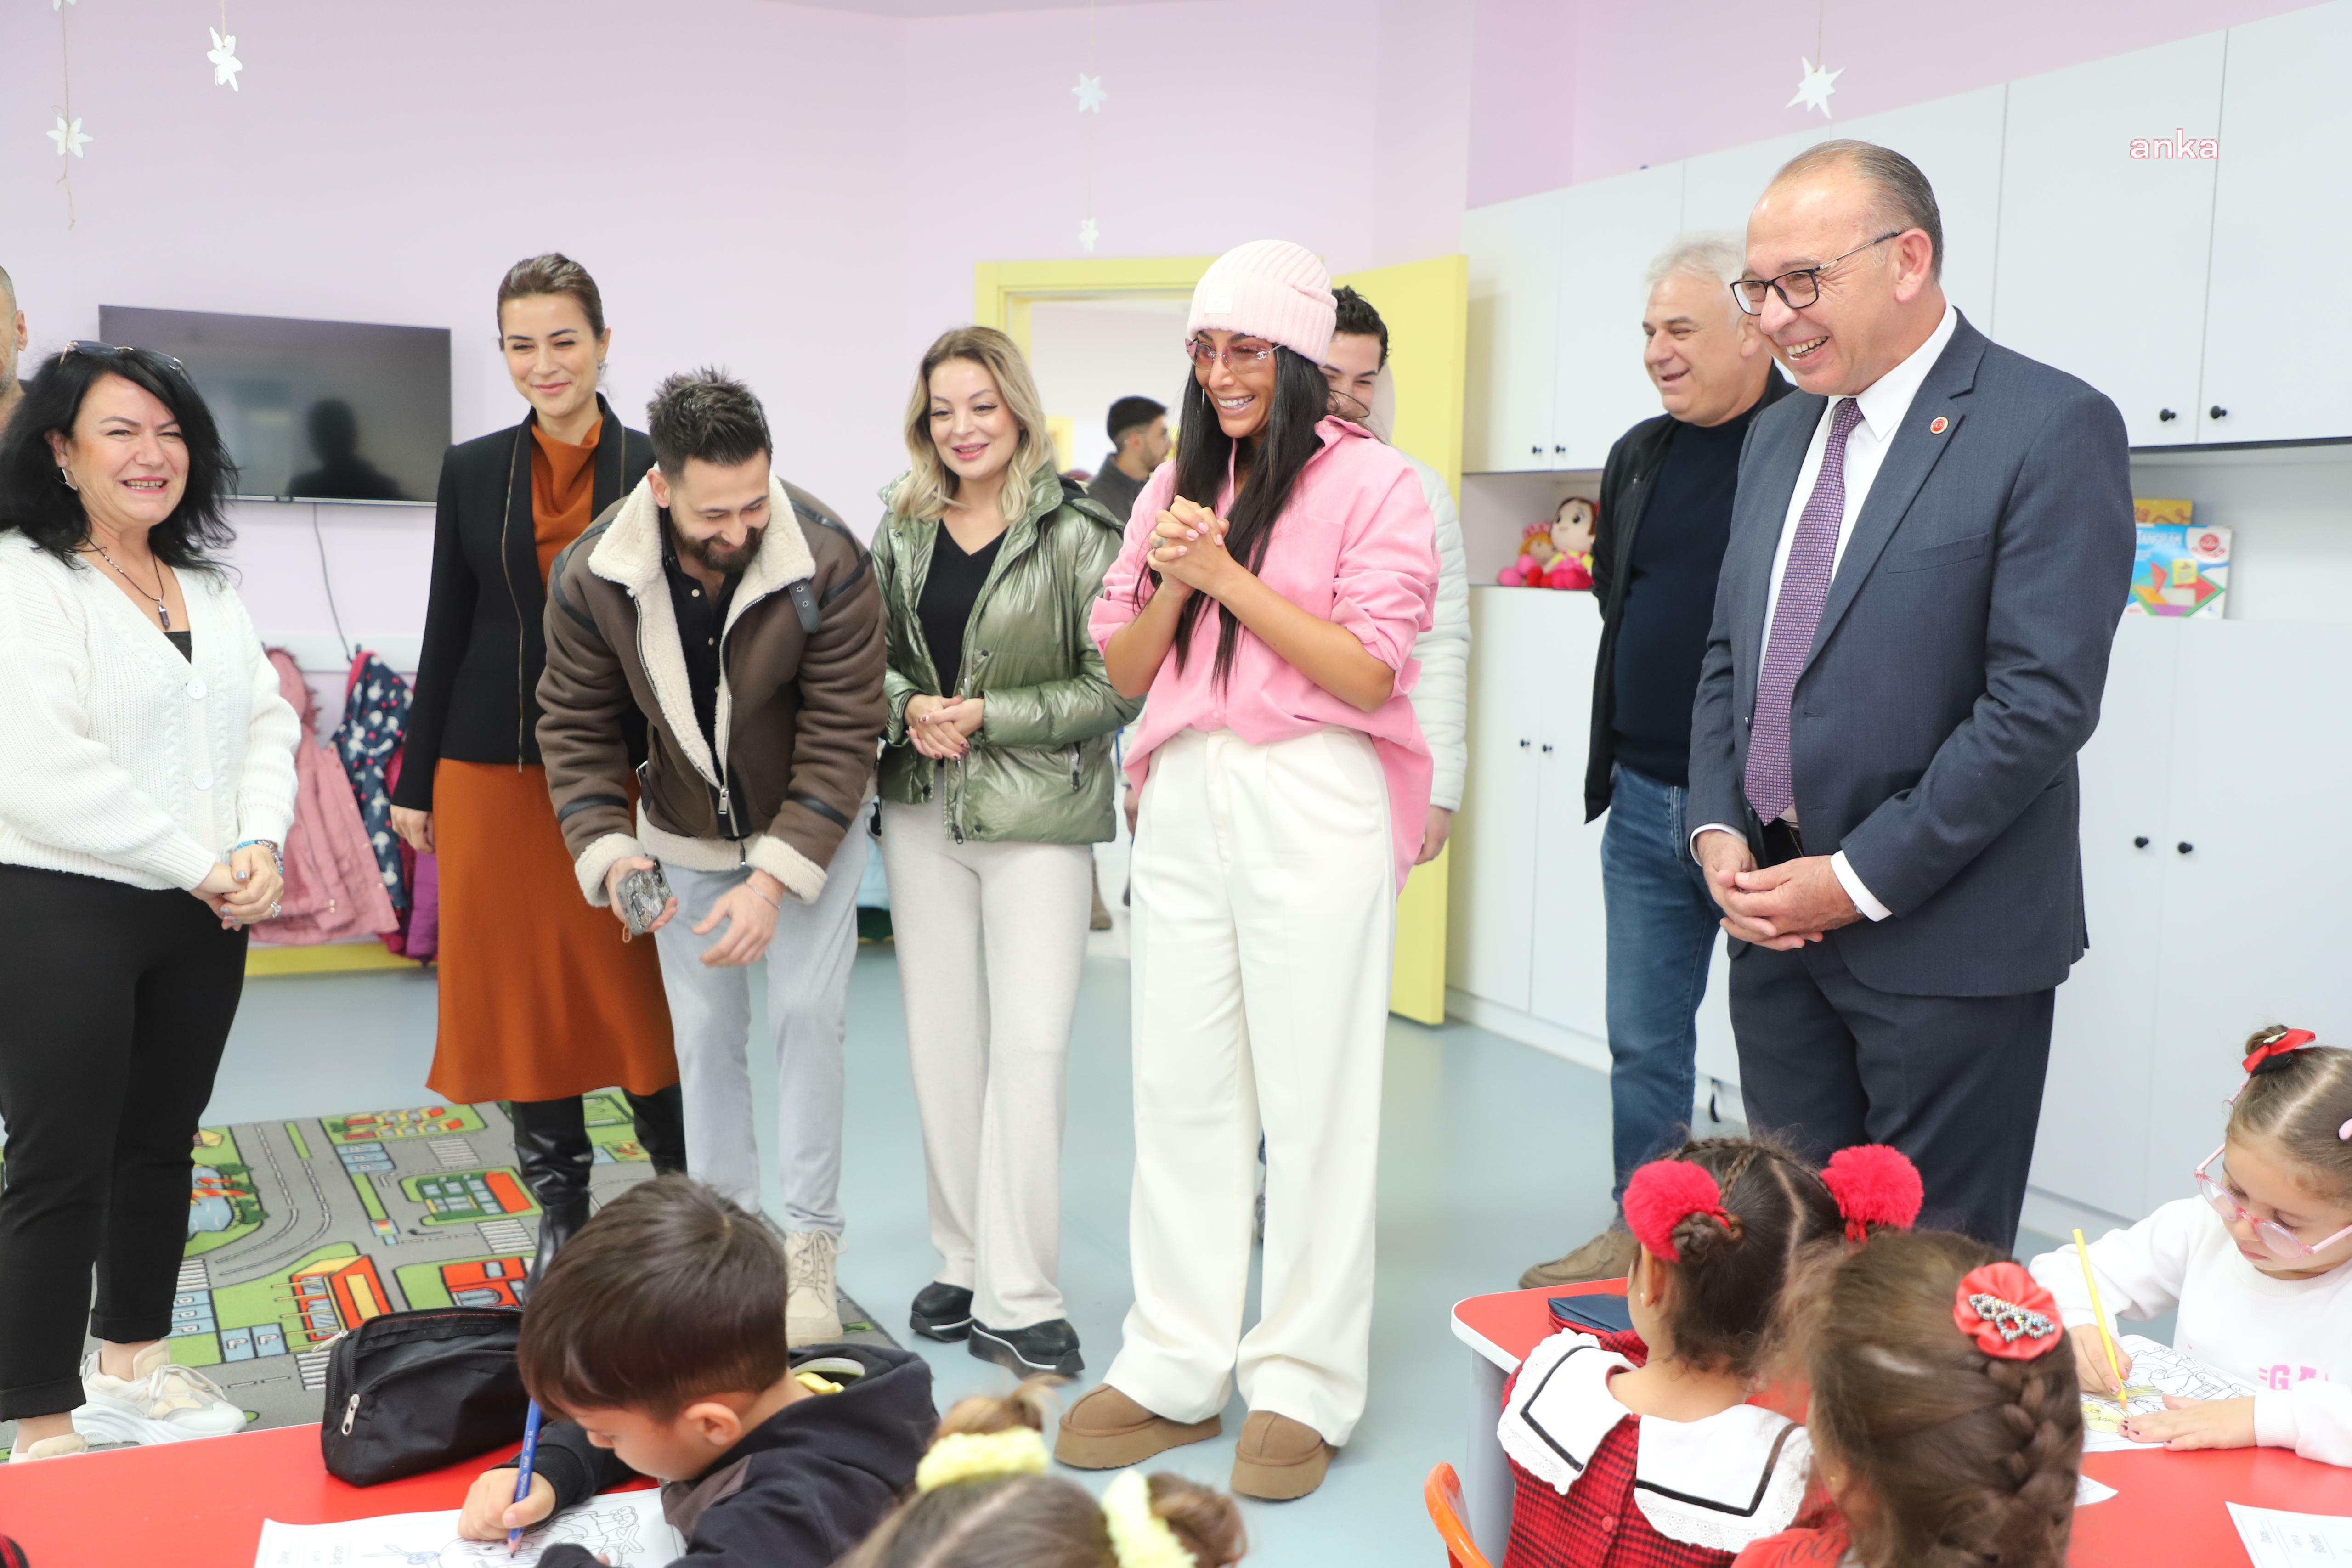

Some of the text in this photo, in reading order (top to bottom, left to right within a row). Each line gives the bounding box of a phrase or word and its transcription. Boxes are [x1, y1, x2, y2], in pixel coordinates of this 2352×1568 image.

[226, 1338, 248, 1349] P
[258, 1333, 279, 1345] P
[2259, 1530, 2273, 1544] Date
[2308, 1534, 2326, 1553] Barber
